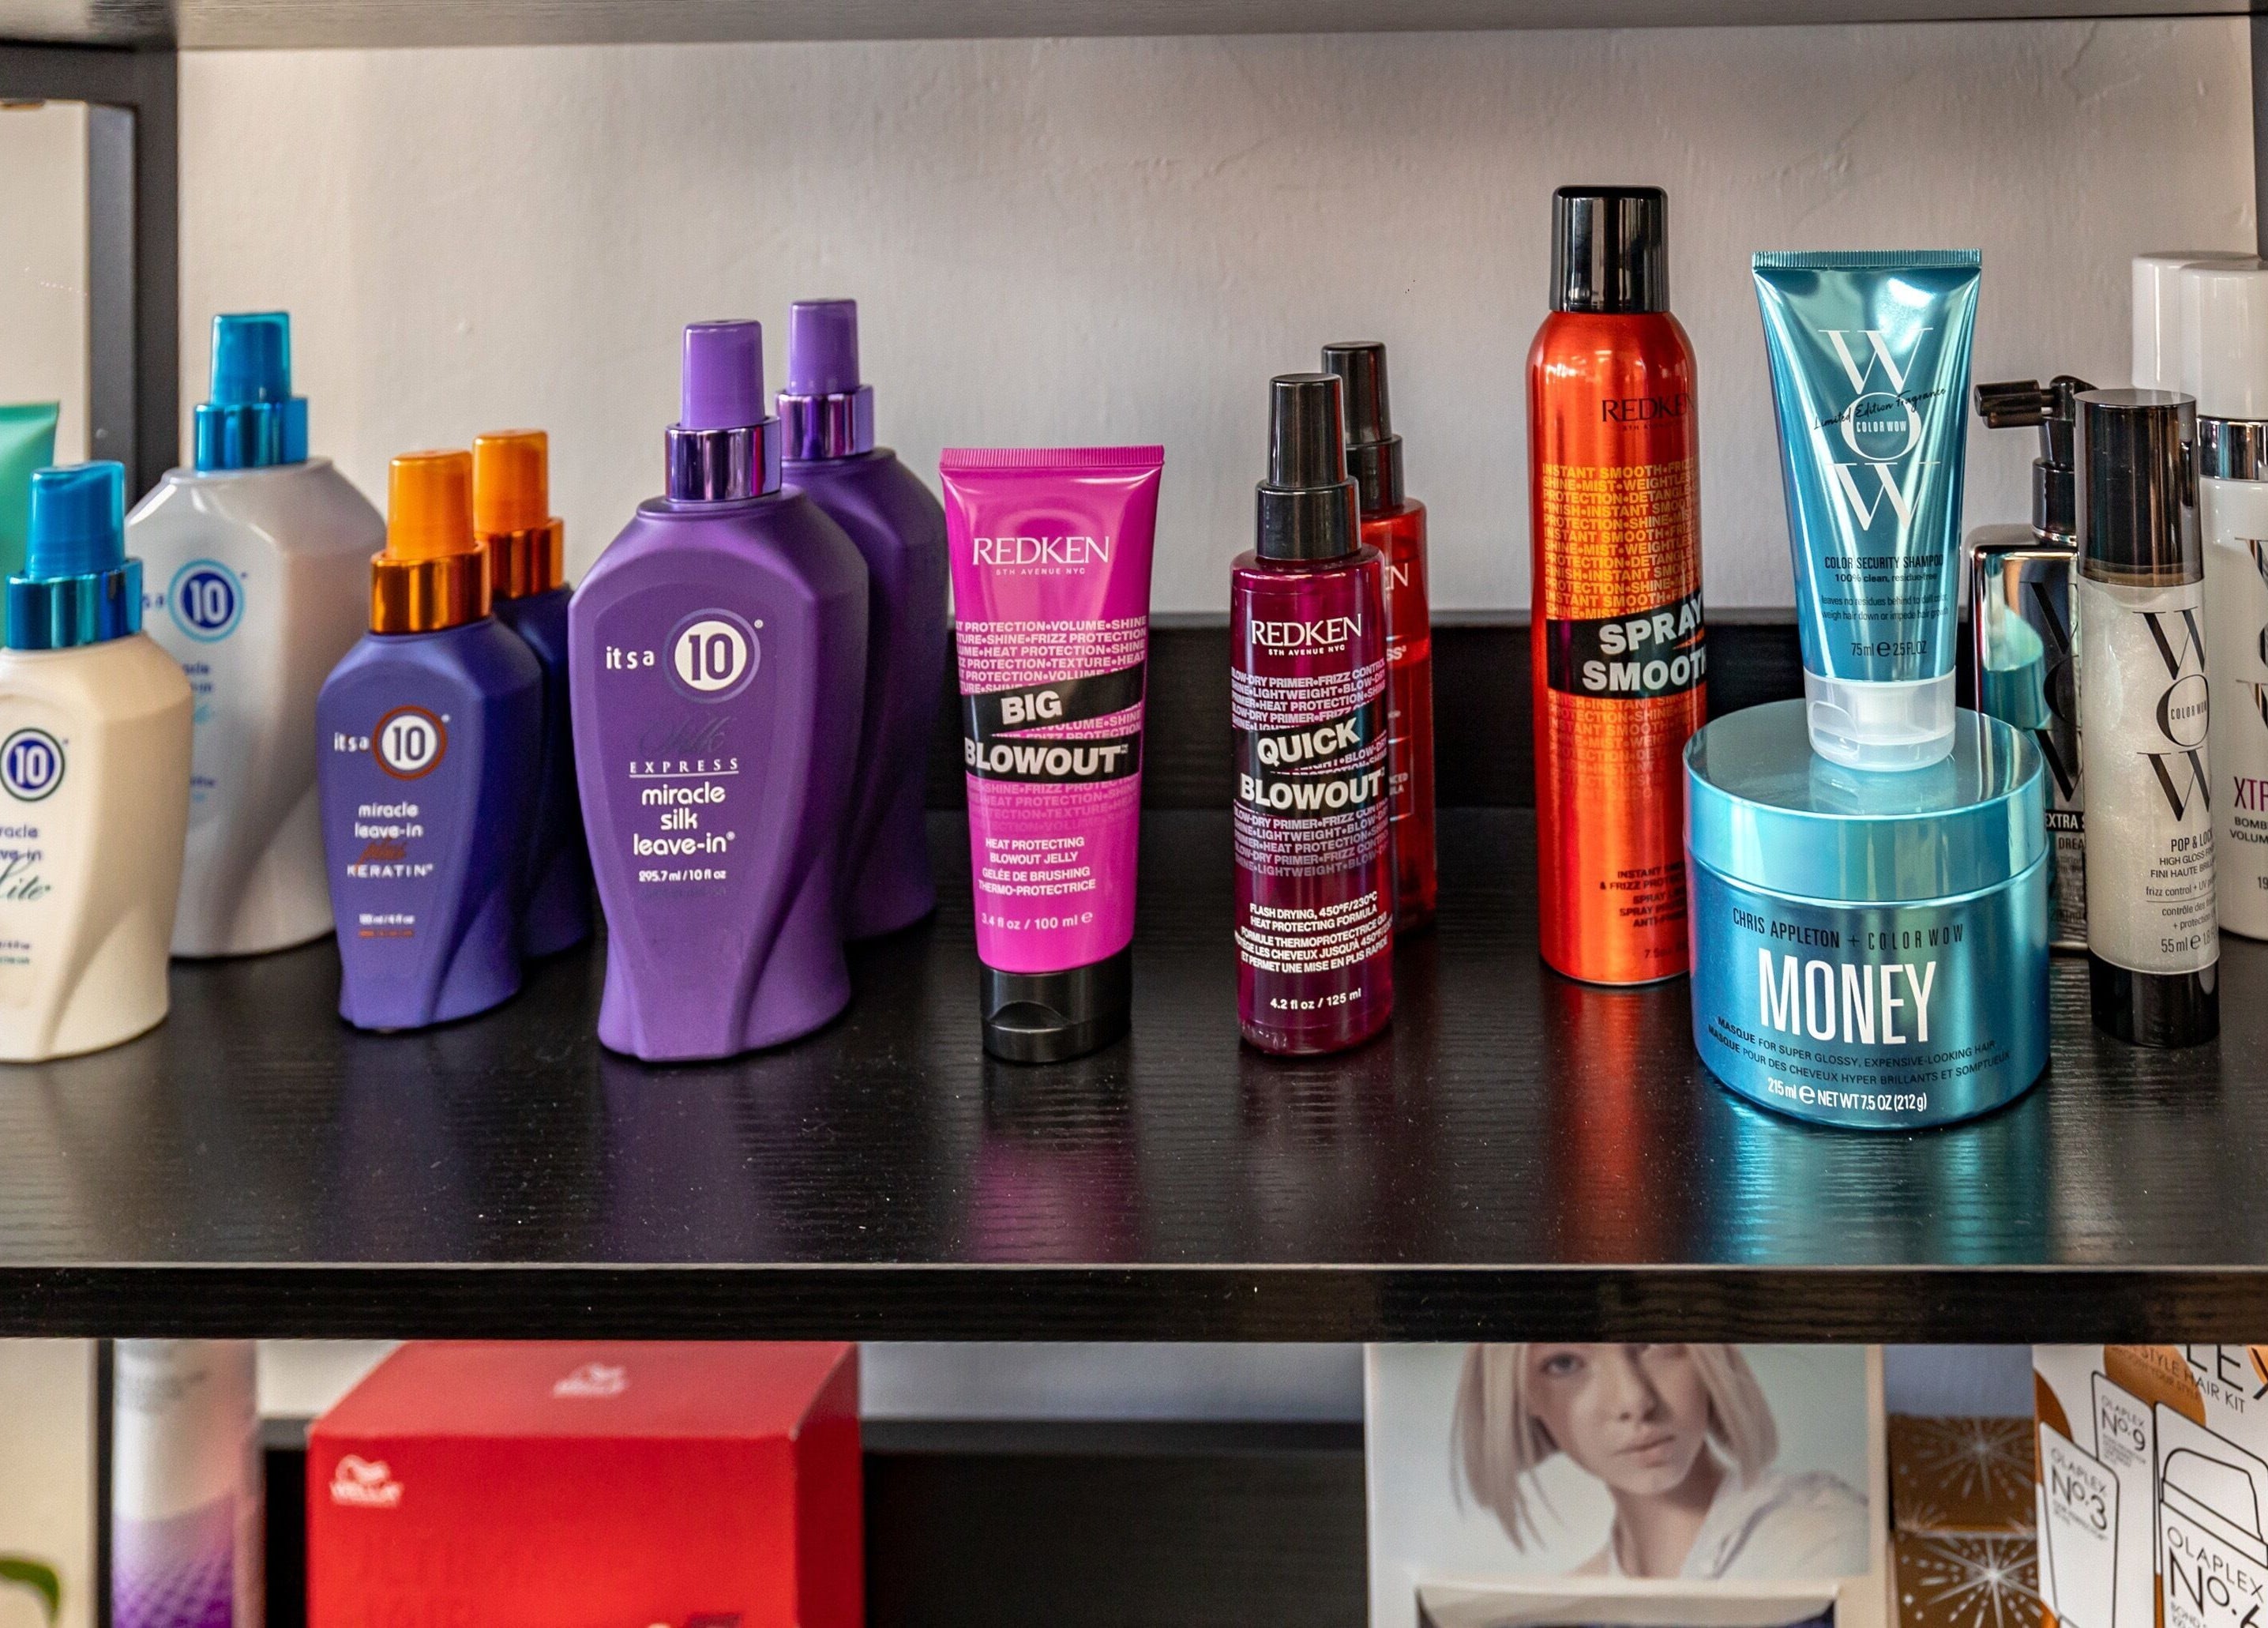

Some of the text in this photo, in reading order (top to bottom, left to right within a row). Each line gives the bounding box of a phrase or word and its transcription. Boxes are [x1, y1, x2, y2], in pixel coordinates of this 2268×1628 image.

[1814, 387, 1947, 430] Limited Edition Fragrance
[1857, 420, 1906, 433] COLOR WOW
[1543, 463, 1595, 479] INSTANT
[1545, 527, 1597, 543] INSTANT
[972, 536, 1110, 566] REDKEN
[1825, 555, 1943, 570] COLOR SECURITY SHAMPOO
[1863, 574, 1890, 583] clean,
[1891, 573, 1937, 582] residue-free
[188, 579, 229, 626] 10
[1822, 596, 1842, 606] leaves
[1855, 596, 1886, 606] residues
[1887, 596, 1911, 605] behind
[1598, 593, 1702, 655] SPRAY
[1822, 611, 1842, 621] weigh
[1858, 612, 1879, 621] down
[1890, 611, 1915, 621] impede
[1252, 614, 1361, 646] REDKEN
[688, 633, 734, 682] 10
[1289, 647, 1324, 656] AVENUE
[1001, 690, 1063, 725] BIG
[2170, 706, 2196, 720] COLOR
[392, 725, 426, 761] 10
[1257, 717, 1360, 766] QUICK
[14, 744, 49, 787] 10
[629, 758, 738, 774] EXPRESS
[641, 781, 727, 806] miracle
[359, 801, 419, 818] miracle
[660, 807, 698, 830] silk
[355, 822, 423, 838] leave-in
[2229, 829, 2268, 844] VOLUM
[986, 837, 1084, 851] HEAT PROTECTING
[2171, 836, 2198, 852] POP &
[990, 852, 1078, 864] BLOWOUT JELLY
[2160, 851, 2205, 866] HIGH GLOSS
[669, 870, 682, 882] ml
[689, 869, 704, 881] 10
[713, 870, 727, 879] oz
[982, 867, 1090, 882] GELÉE DE BRUSHING
[2150, 866, 2198, 878] FINI HAUTE
[978, 879, 1096, 896] THERMO-PROTECTRICE
[1609, 881, 1642, 891] FRIZZ
[2146, 885, 2162, 897] frizz
[2165, 884, 2191, 897] control
[1250, 903, 1318, 920] FLASH DRYING,
[1250, 904, 1377, 932] HEAT PROTECTING FORMULA
[1620, 906, 1652, 917] SPRAY
[2162, 904, 2193, 916] contrôle
[1007, 919, 1020, 930] oz
[1034, 918, 1058, 929] 100
[1062, 915, 1077, 927] ml
[1733, 907, 1963, 950] CHRIS APPLETON COLOR WOW
[2180, 912, 2210, 931] protection
[1241, 921, 1376, 947] FORMULE THERMOPROTECTRICE
[1256, 946, 1270, 957] LES
[1271, 949, 1318, 961] CHEVEUX
[2161, 937, 2187, 953] 55 ml
[1241, 950, 1249, 963] ET
[1249, 954, 1280, 972] PERMET
[1282, 962, 1302, 973] UNE
[1304, 960, 1329, 972] MISE
[1331, 956, 1345, 969] EN
[1346, 950, 1365, 966] PLIS
[1270, 998, 1287, 1010] 4.2
[1290, 999, 1298, 1010] fl
[1327, 993, 1346, 1006] 125
[1350, 987, 1361, 1000] ml
[1758, 947, 1936, 1044] MONEY
[1718, 1016, 1996, 1068] MASQUE FOR SUPER GLOSSY, EXPENSIVE-LOOKING HAIR
[1708, 1025, 2010, 1085] MASQUE POUR DES CHEVEUX HYPER BRILLANTS ET SOMPTUEUX
[1817, 1090, 1838, 1107] NET
[1840, 1092, 1861, 1110] WT
[1861, 1096, 1876, 1111] 7.5
[1878, 1096, 1893, 1111] OZ
[2225, 1390, 2246, 1414] KIT
[2168, 1525, 2266, 1604] OLAPLEX
